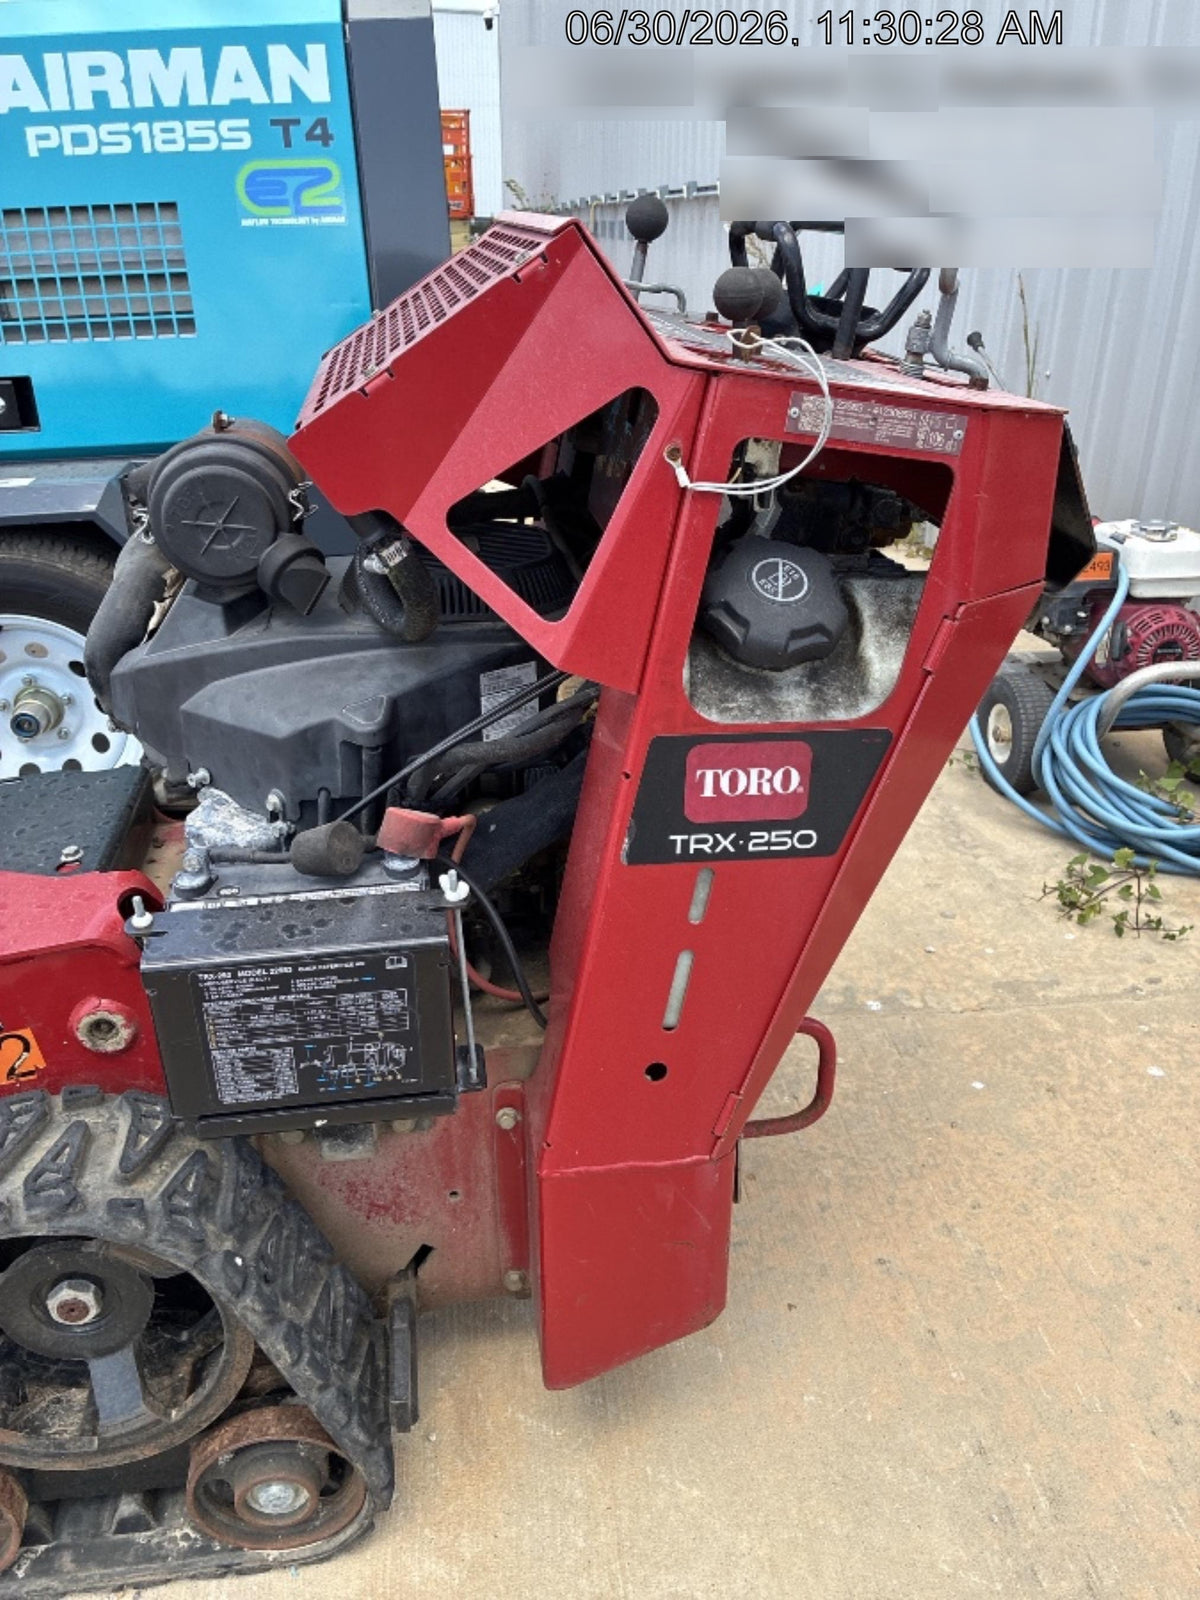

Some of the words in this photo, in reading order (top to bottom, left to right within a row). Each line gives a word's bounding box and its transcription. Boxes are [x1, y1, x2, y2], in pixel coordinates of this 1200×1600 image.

[0, 43, 331, 114] AIRMAN
[24, 118, 252, 157] PDS185S
[1083, 560, 1111, 573] 493
